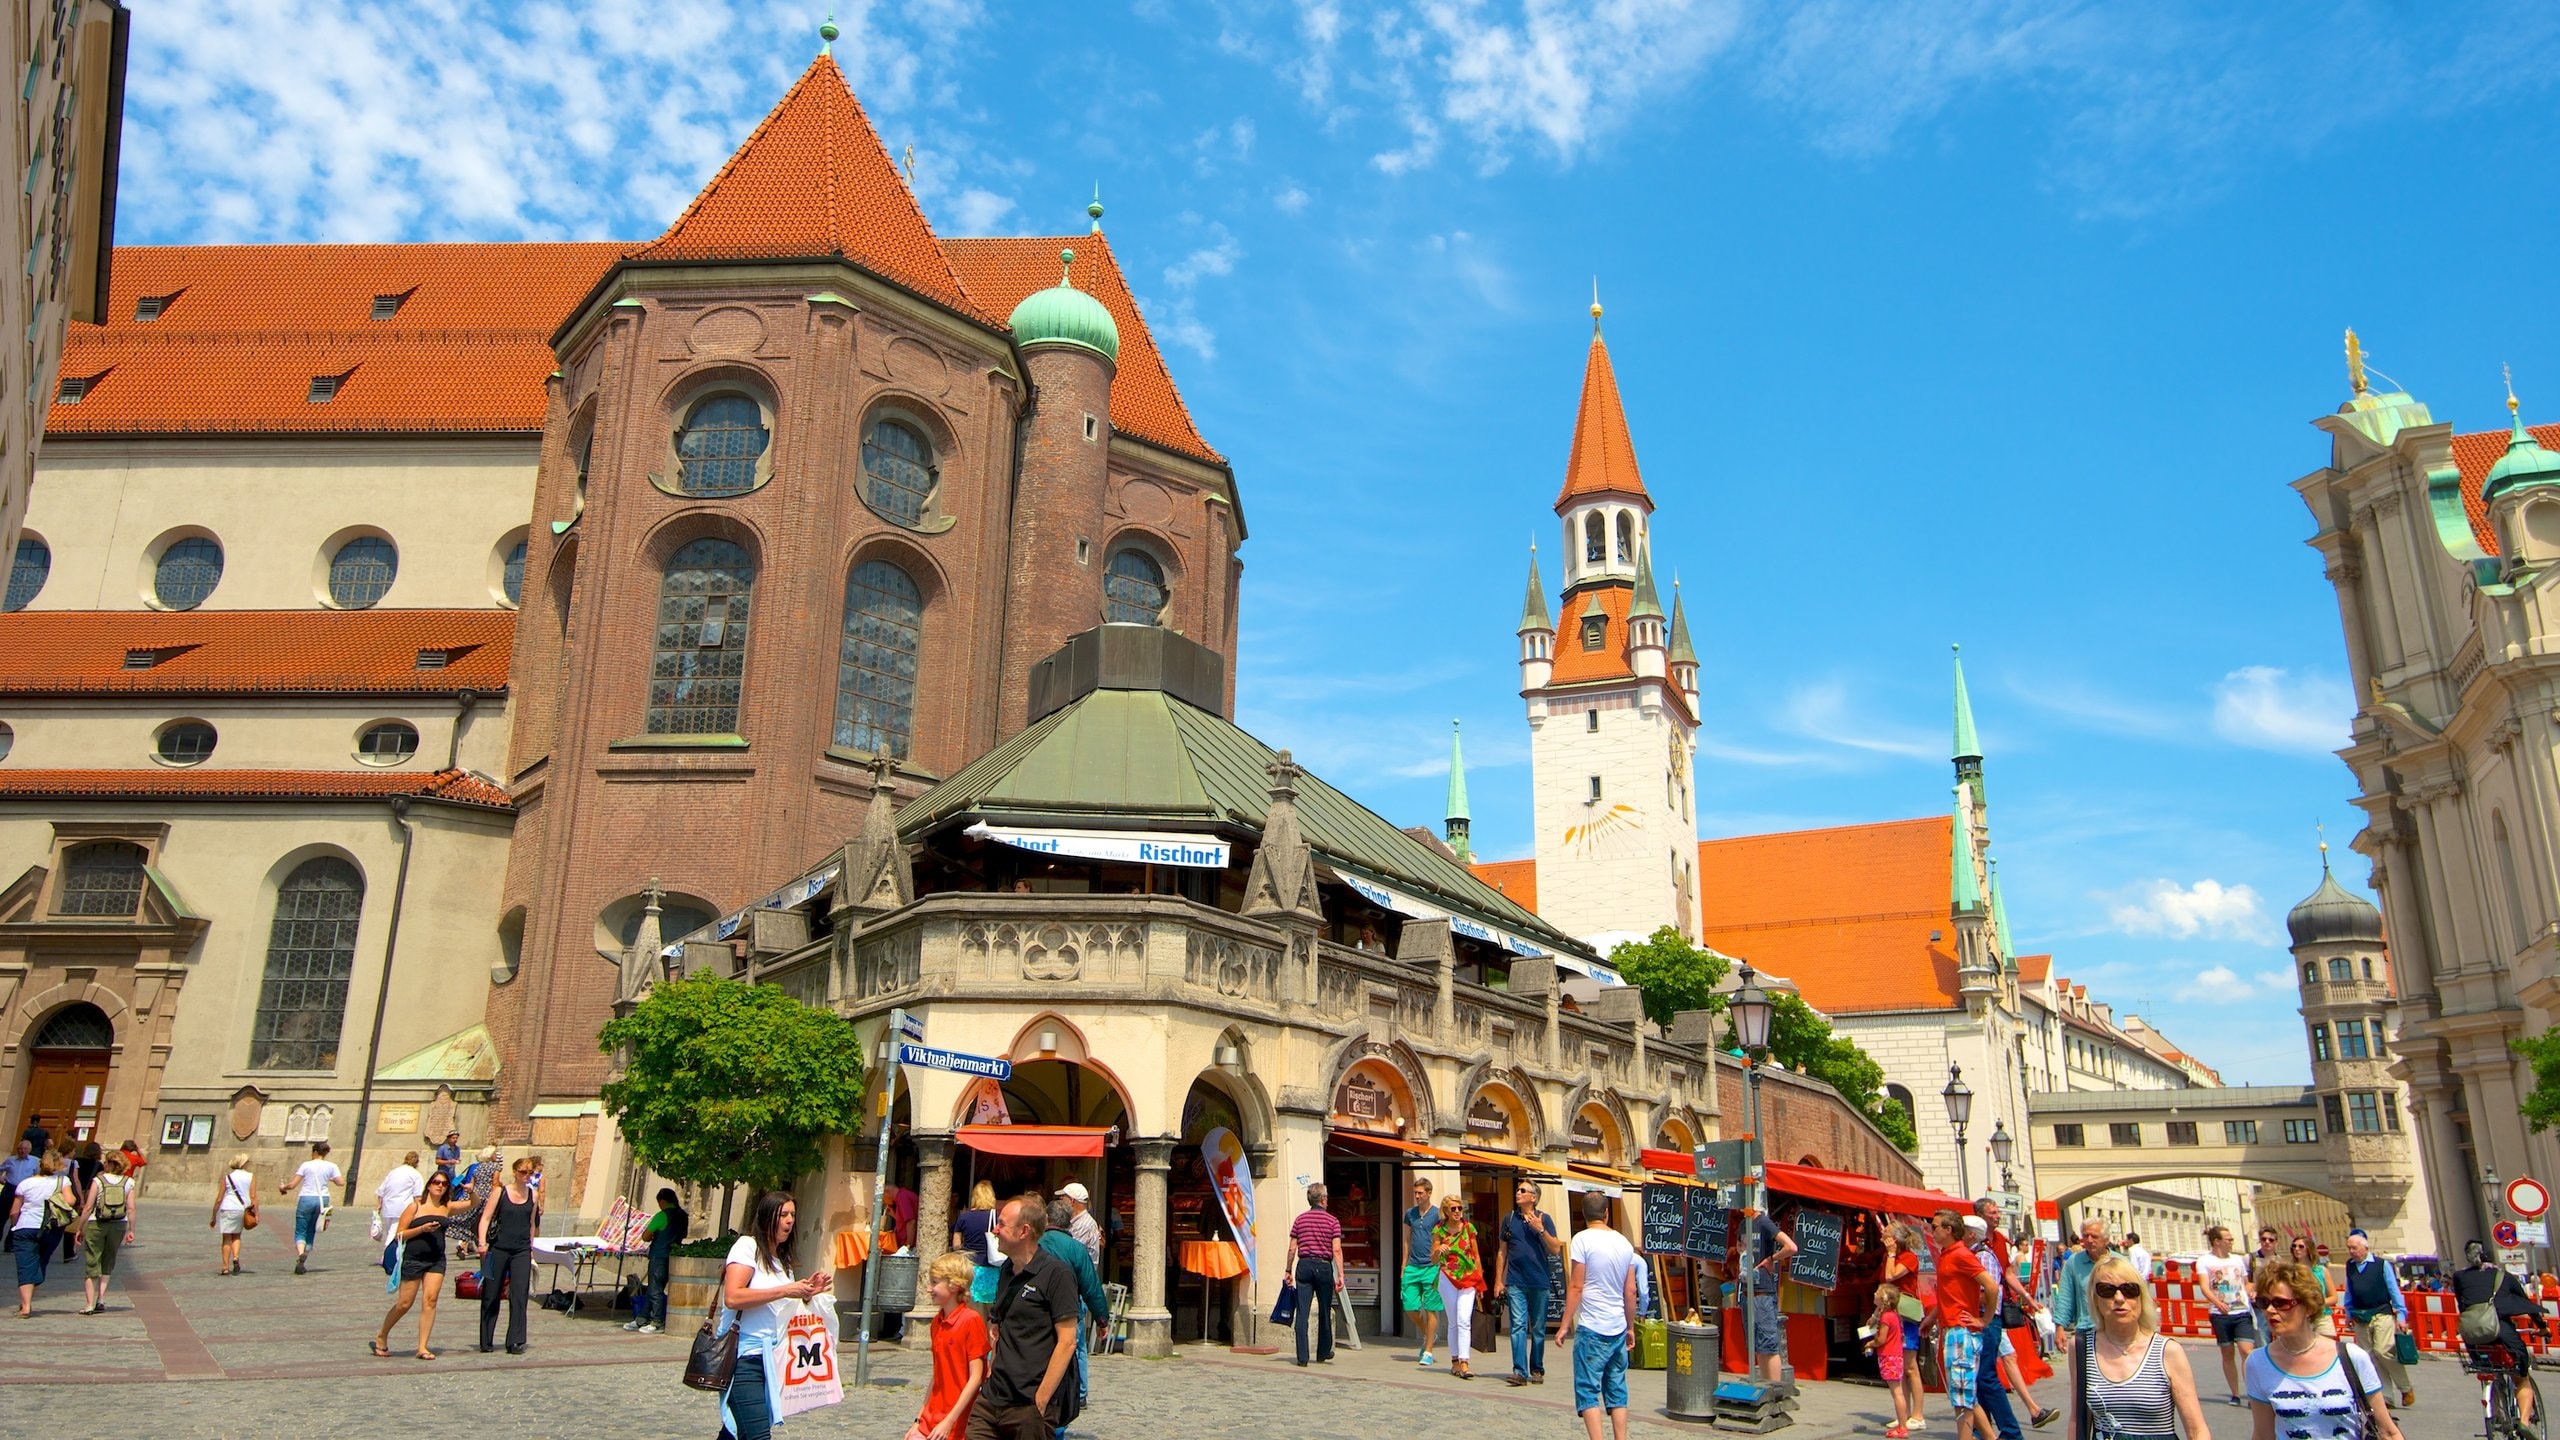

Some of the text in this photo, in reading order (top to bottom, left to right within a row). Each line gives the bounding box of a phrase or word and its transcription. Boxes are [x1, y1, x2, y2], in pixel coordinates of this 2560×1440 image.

[1139, 842, 1223, 865] Rischart
[1451, 915, 1491, 940] Rischart
[907, 1046, 1004, 1076] Viktualienmarkt
[1651, 1188, 1680, 1204] Herz-
[1643, 1202, 1684, 1224] Kirschen
[1655, 1225, 1673, 1236] vom
[1796, 1212, 1841, 1242] Aprikosen
[1807, 1239, 1827, 1250] aus
[1792, 1254, 1836, 1282] Frankreich
[797, 1342, 823, 1368] M
